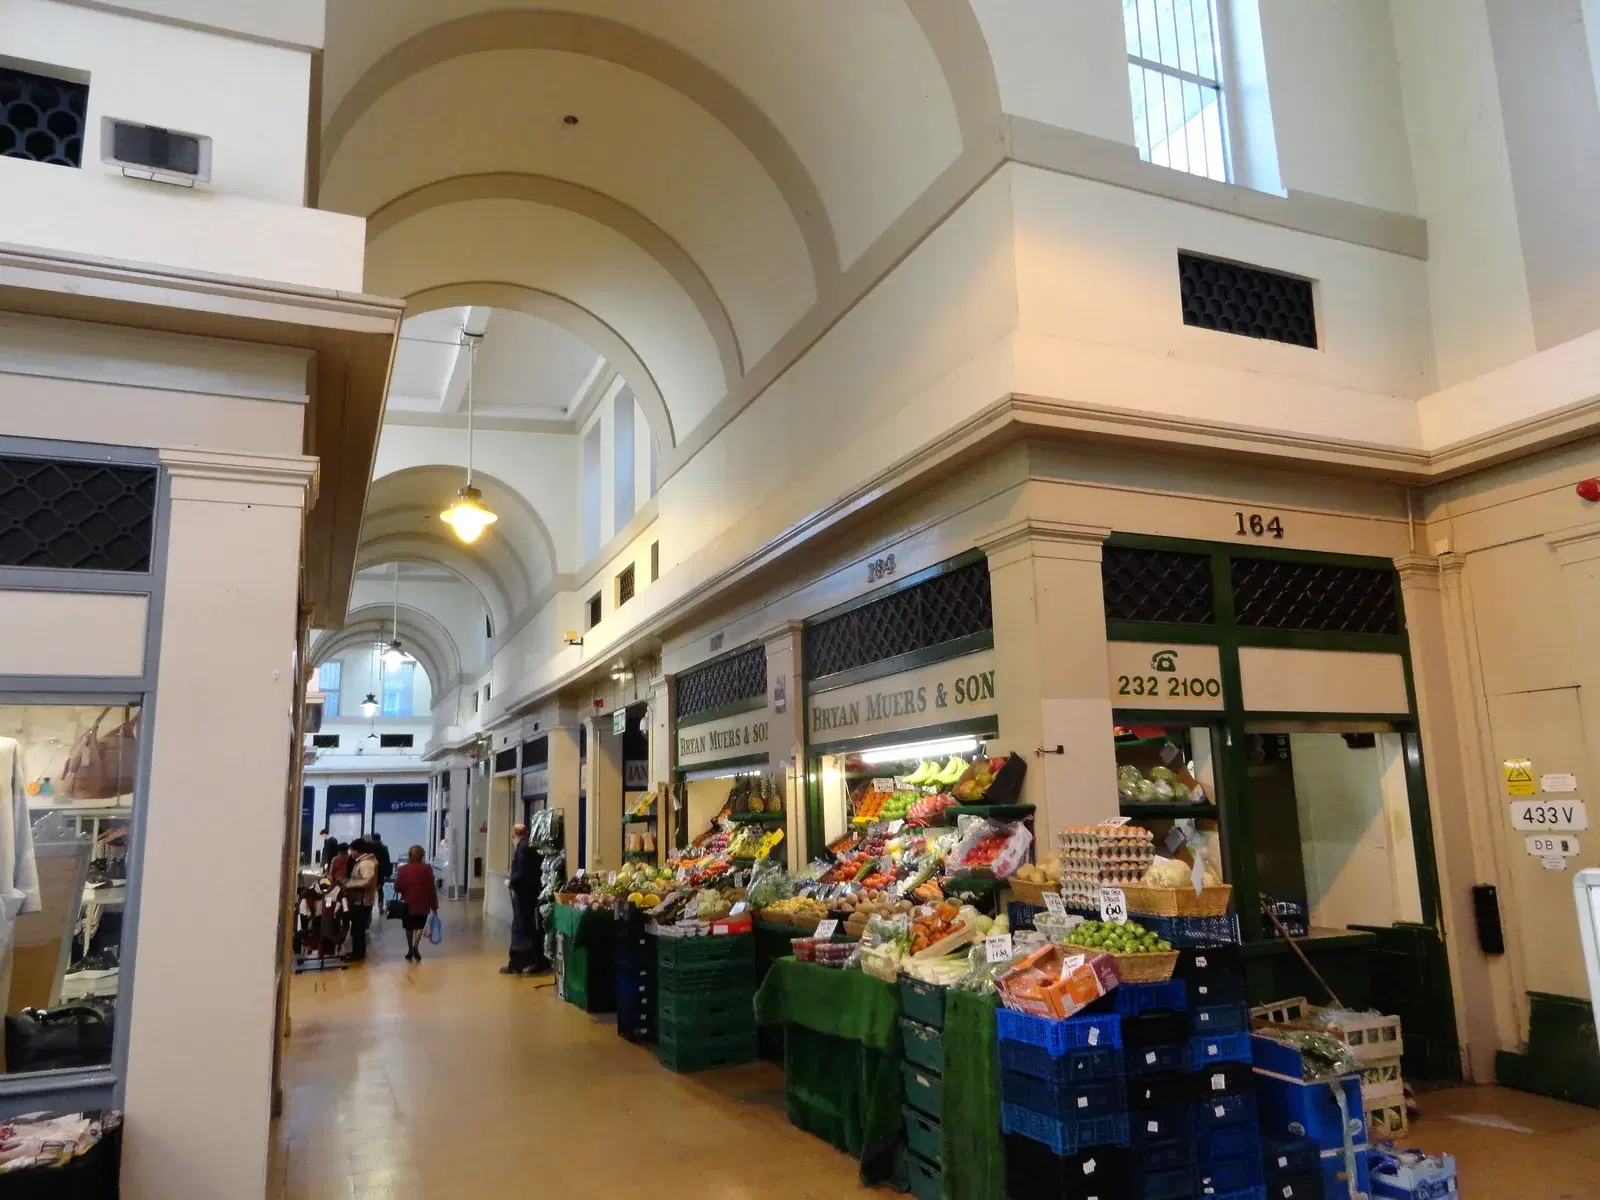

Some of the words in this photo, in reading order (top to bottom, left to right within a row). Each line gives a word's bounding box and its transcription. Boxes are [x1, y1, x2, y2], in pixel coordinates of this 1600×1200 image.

[1234, 512, 1284, 539] 164
[867, 553, 896, 583] 164
[1118, 675, 1158, 696] 232
[1168, 677, 1221, 697] 2100
[812, 701, 859, 732] BRYAN
[866, 686, 927, 722] MUERS
[936, 682, 948, 708] &
[955, 670, 995, 704] SON
[709, 728, 741, 751] MUERS
[744, 726, 750, 744] &
[1534, 840, 1553, 850] DB
